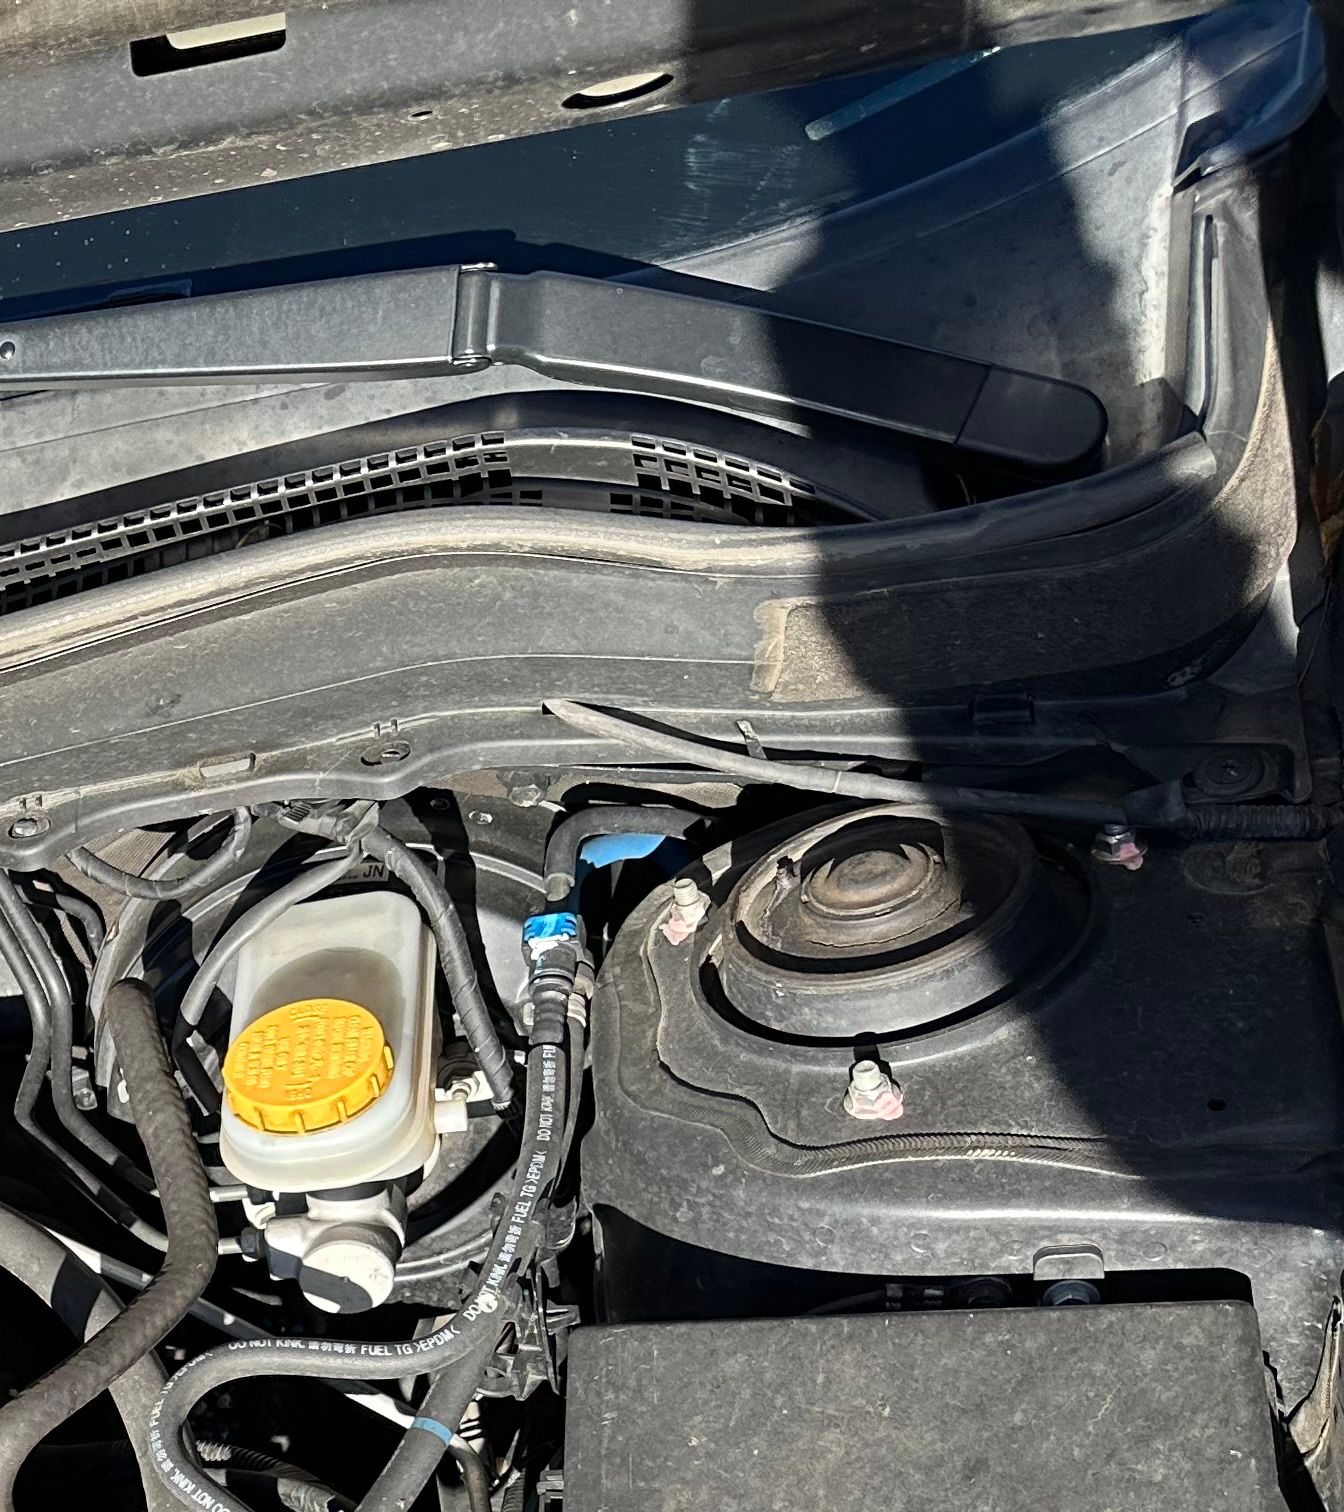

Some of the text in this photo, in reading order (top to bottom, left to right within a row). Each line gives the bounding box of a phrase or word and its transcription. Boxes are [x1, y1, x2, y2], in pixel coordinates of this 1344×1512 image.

[362, 864, 386, 879] JN
[536, 1127, 552, 1142] DO
[520, 1184, 537, 1200] TG
[511, 1200, 532, 1224] FUEL
[463, 1303, 481, 1322] DO
[360, 1343, 393, 1358] FUEL
[394, 1342, 413, 1357] TG
[191, 1484, 216, 1510] NOT
